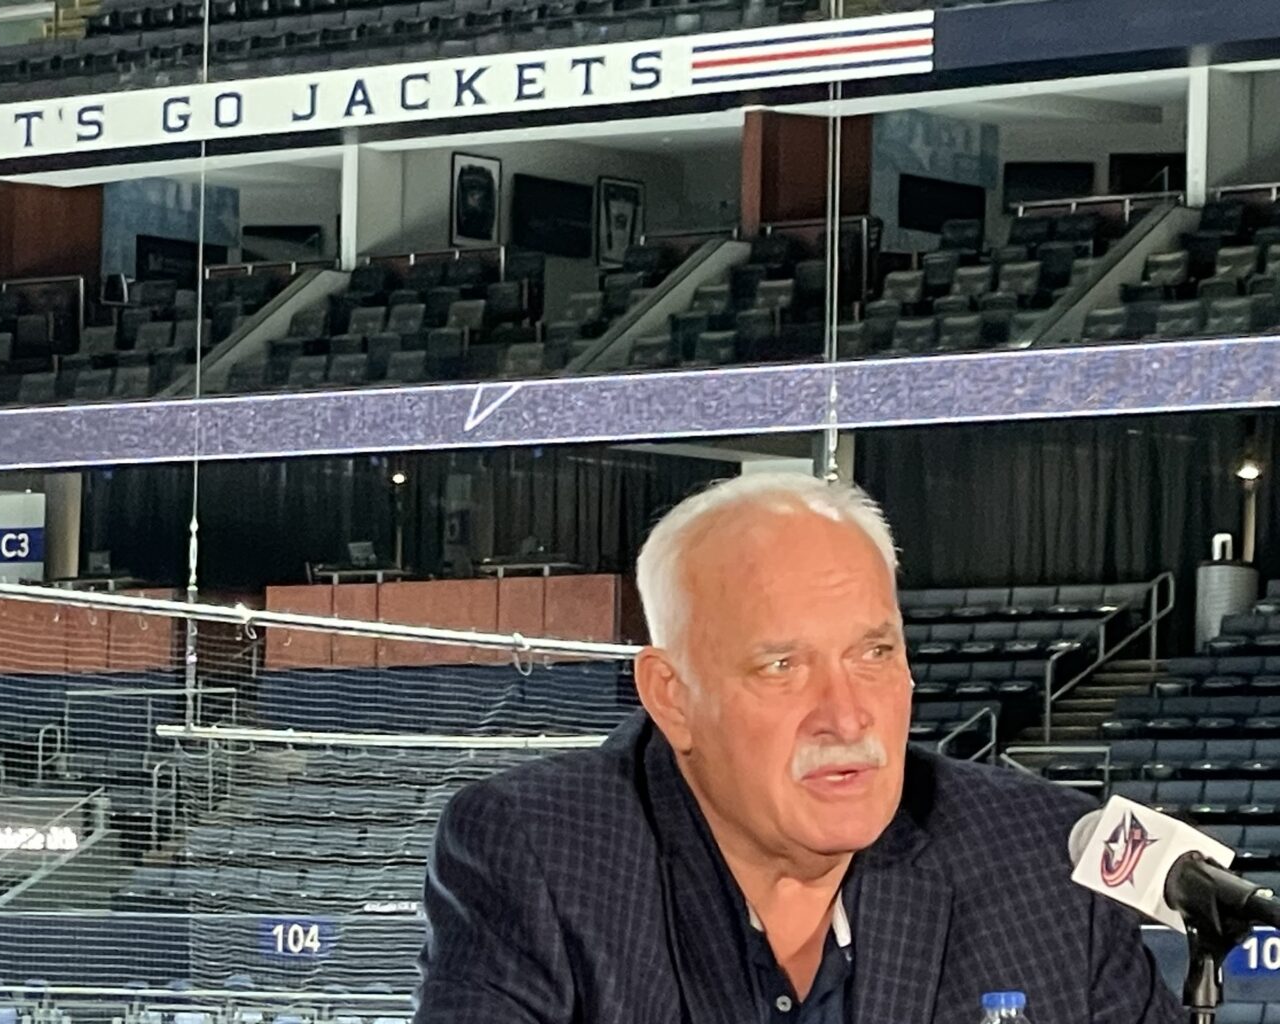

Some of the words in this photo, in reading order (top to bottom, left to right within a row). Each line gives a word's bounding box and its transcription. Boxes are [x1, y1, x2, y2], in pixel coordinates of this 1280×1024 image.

[162, 91, 244, 134] GO
[291, 50, 663, 122] JACKETS
[1, 533, 29, 558] C3
[272, 923, 321, 954] 104
